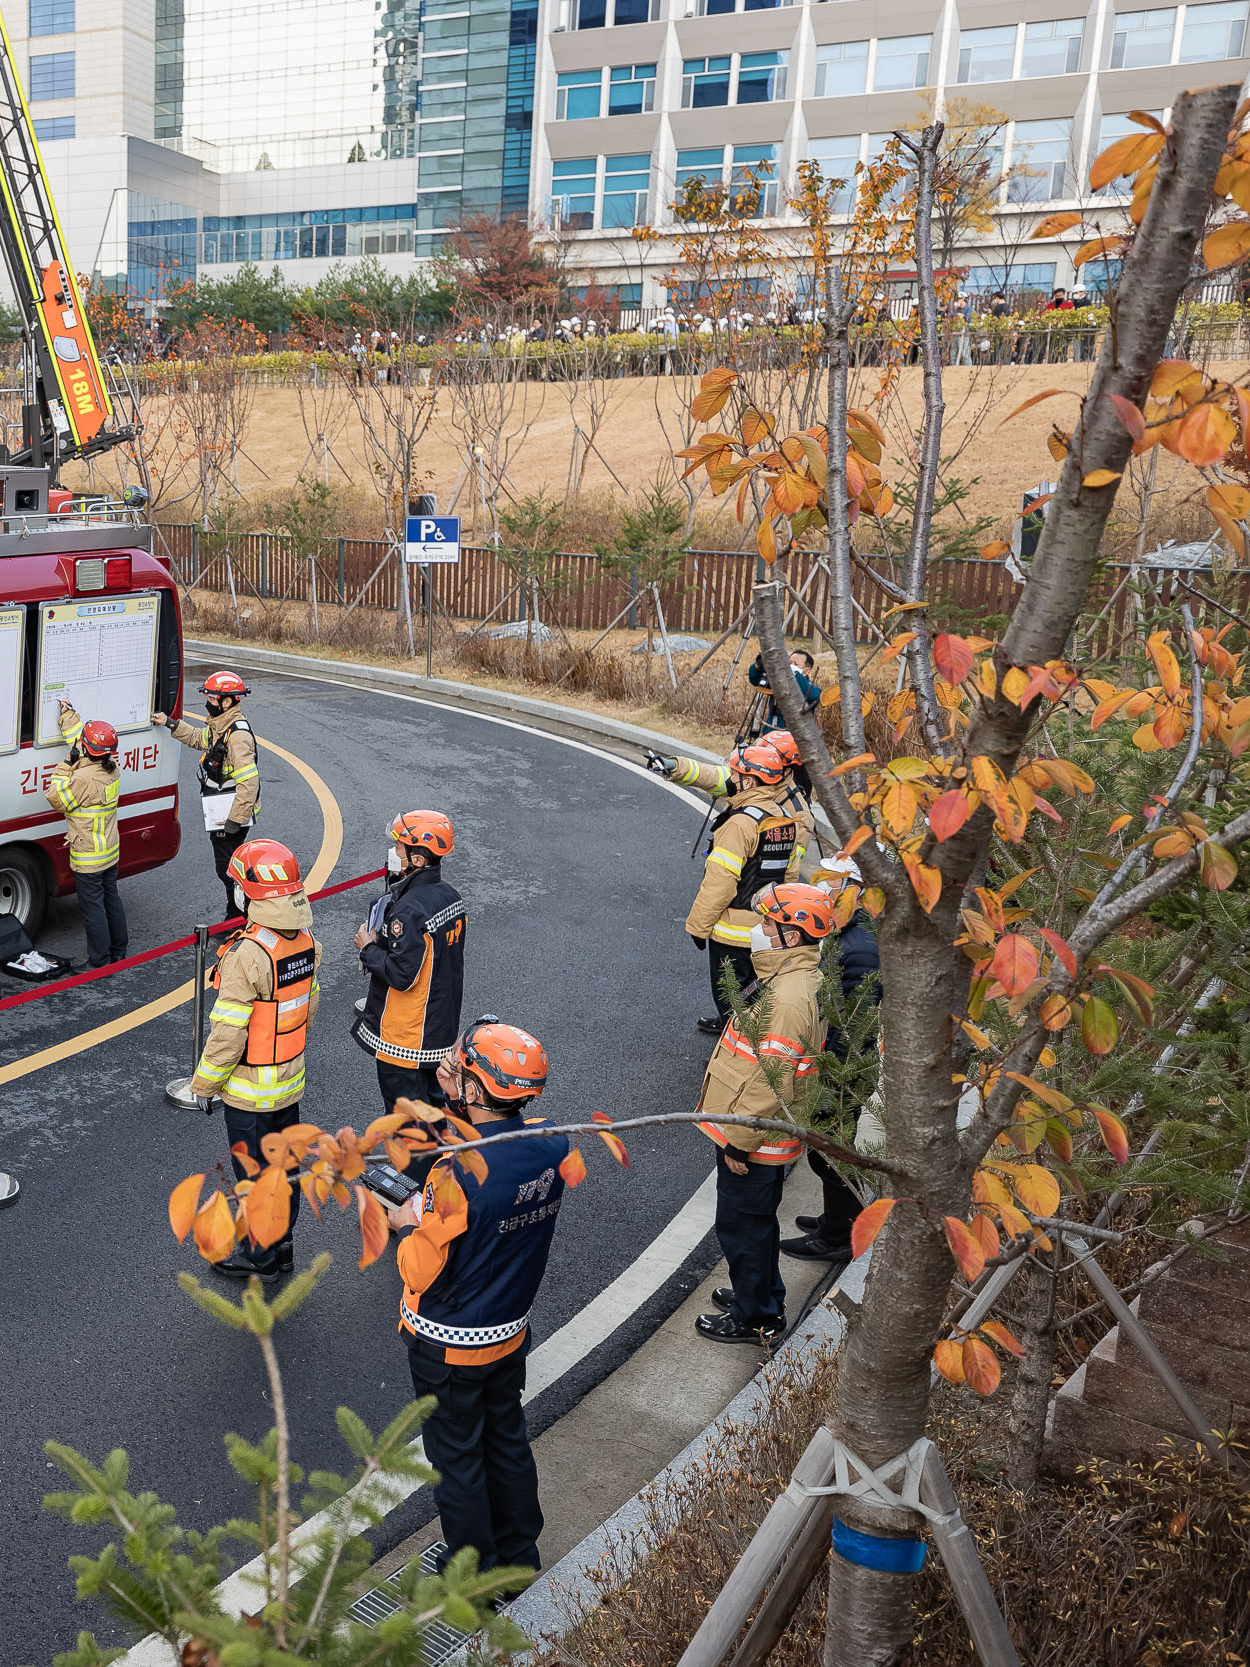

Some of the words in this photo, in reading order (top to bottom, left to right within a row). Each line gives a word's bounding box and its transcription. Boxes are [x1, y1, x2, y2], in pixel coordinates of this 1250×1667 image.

[69, 368, 95, 415] 18M
[420, 520, 436, 541] P
[765, 826, 795, 842] 서울소방
[514, 1167, 555, 1205] 119
